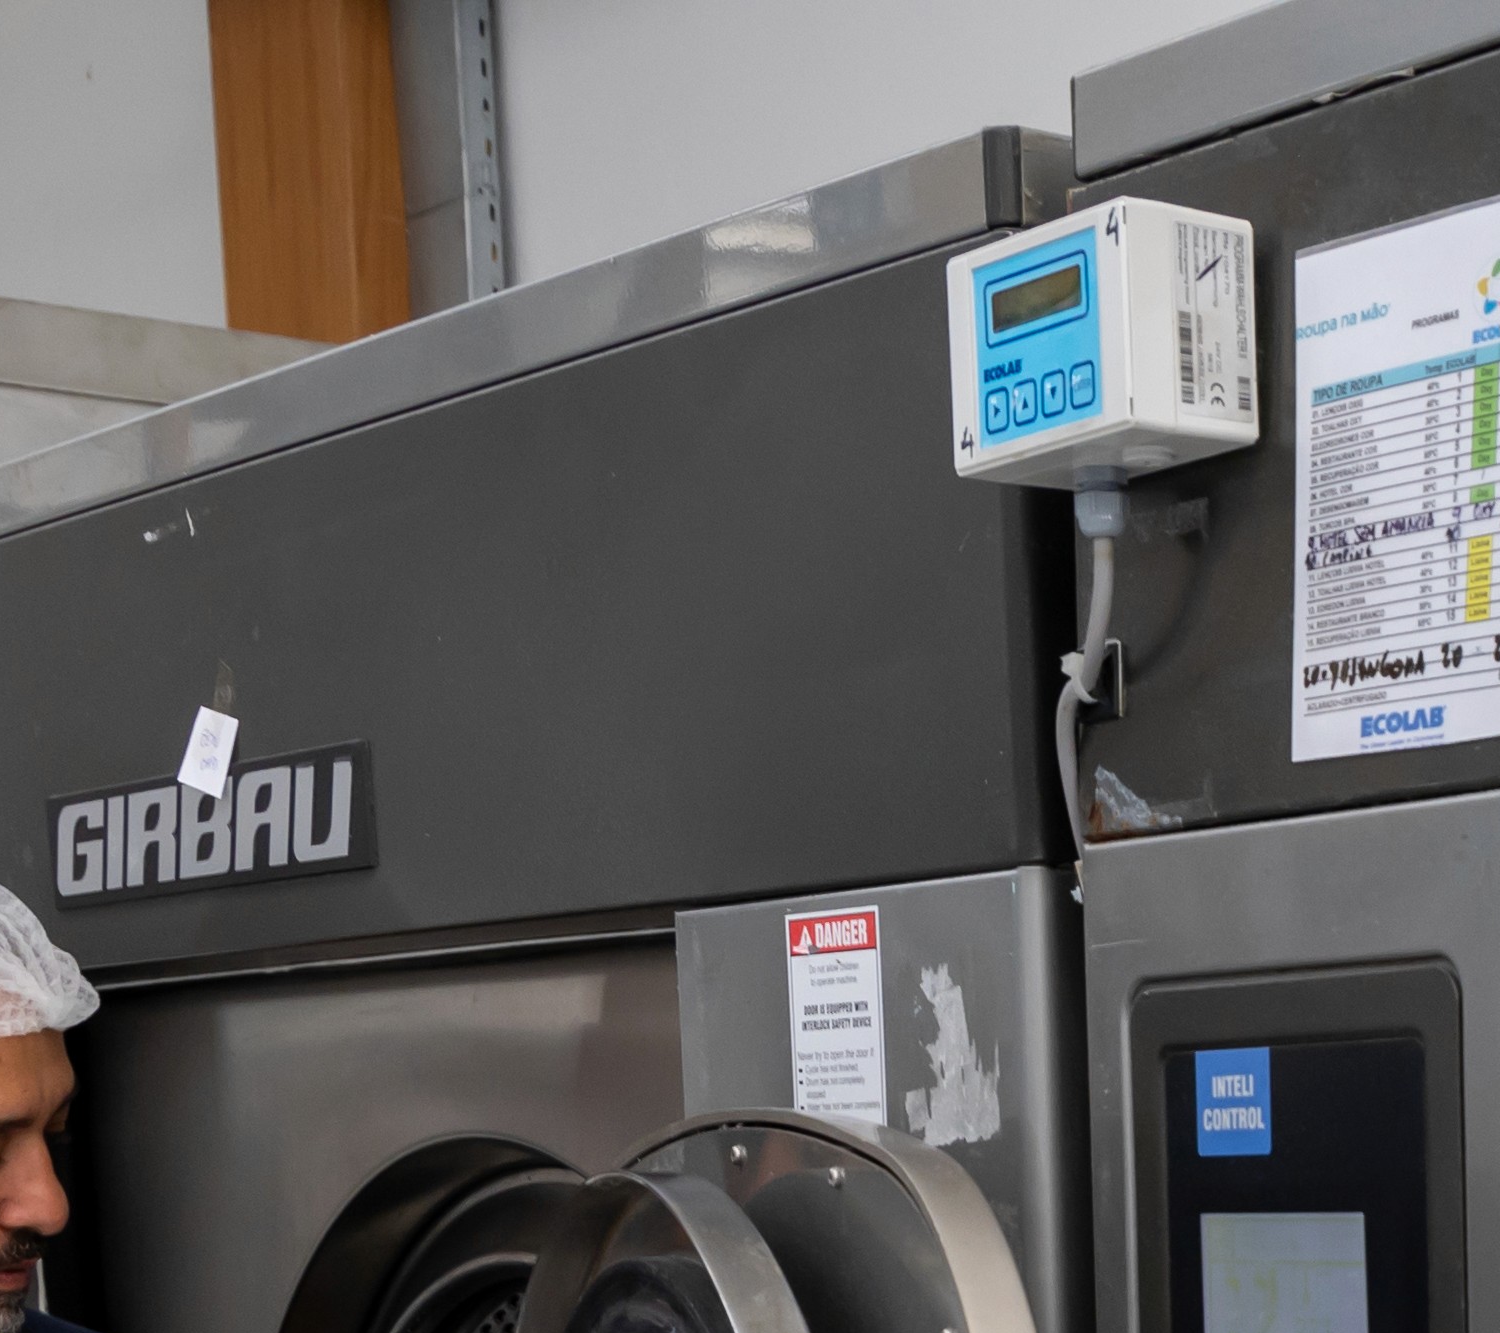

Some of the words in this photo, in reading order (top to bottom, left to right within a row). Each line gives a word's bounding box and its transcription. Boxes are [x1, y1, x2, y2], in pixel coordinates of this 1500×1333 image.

[1341, 312, 1357, 328] na
[1411, 310, 1459, 329] PROGRAMAS
[983, 356, 1022, 385] ECOLAB
[1313, 385, 1333, 401] TIPO
[1335, 382, 1347, 396] DE
[1350, 373, 1383, 392] ROUPA
[1448, 558, 1457, 571] 12
[1360, 705, 1445, 738] ECOLAB
[56, 758, 353, 897] GIRBAU
[814, 918, 868, 949] DANGER
[803, 1003, 818, 1016] DOOR
[819, 1003, 824, 1014] IS
[826, 1000, 852, 1014] EQUIPPED
[854, 1000, 868, 1011] WITH
[801, 1018, 830, 1032] INTERLOCK
[831, 1016, 850, 1030] SAFETY
[852, 1015, 871, 1028] DEVICE
[1212, 1074, 1254, 1098] INTELI
[1203, 1106, 1265, 1132] CONTROL
